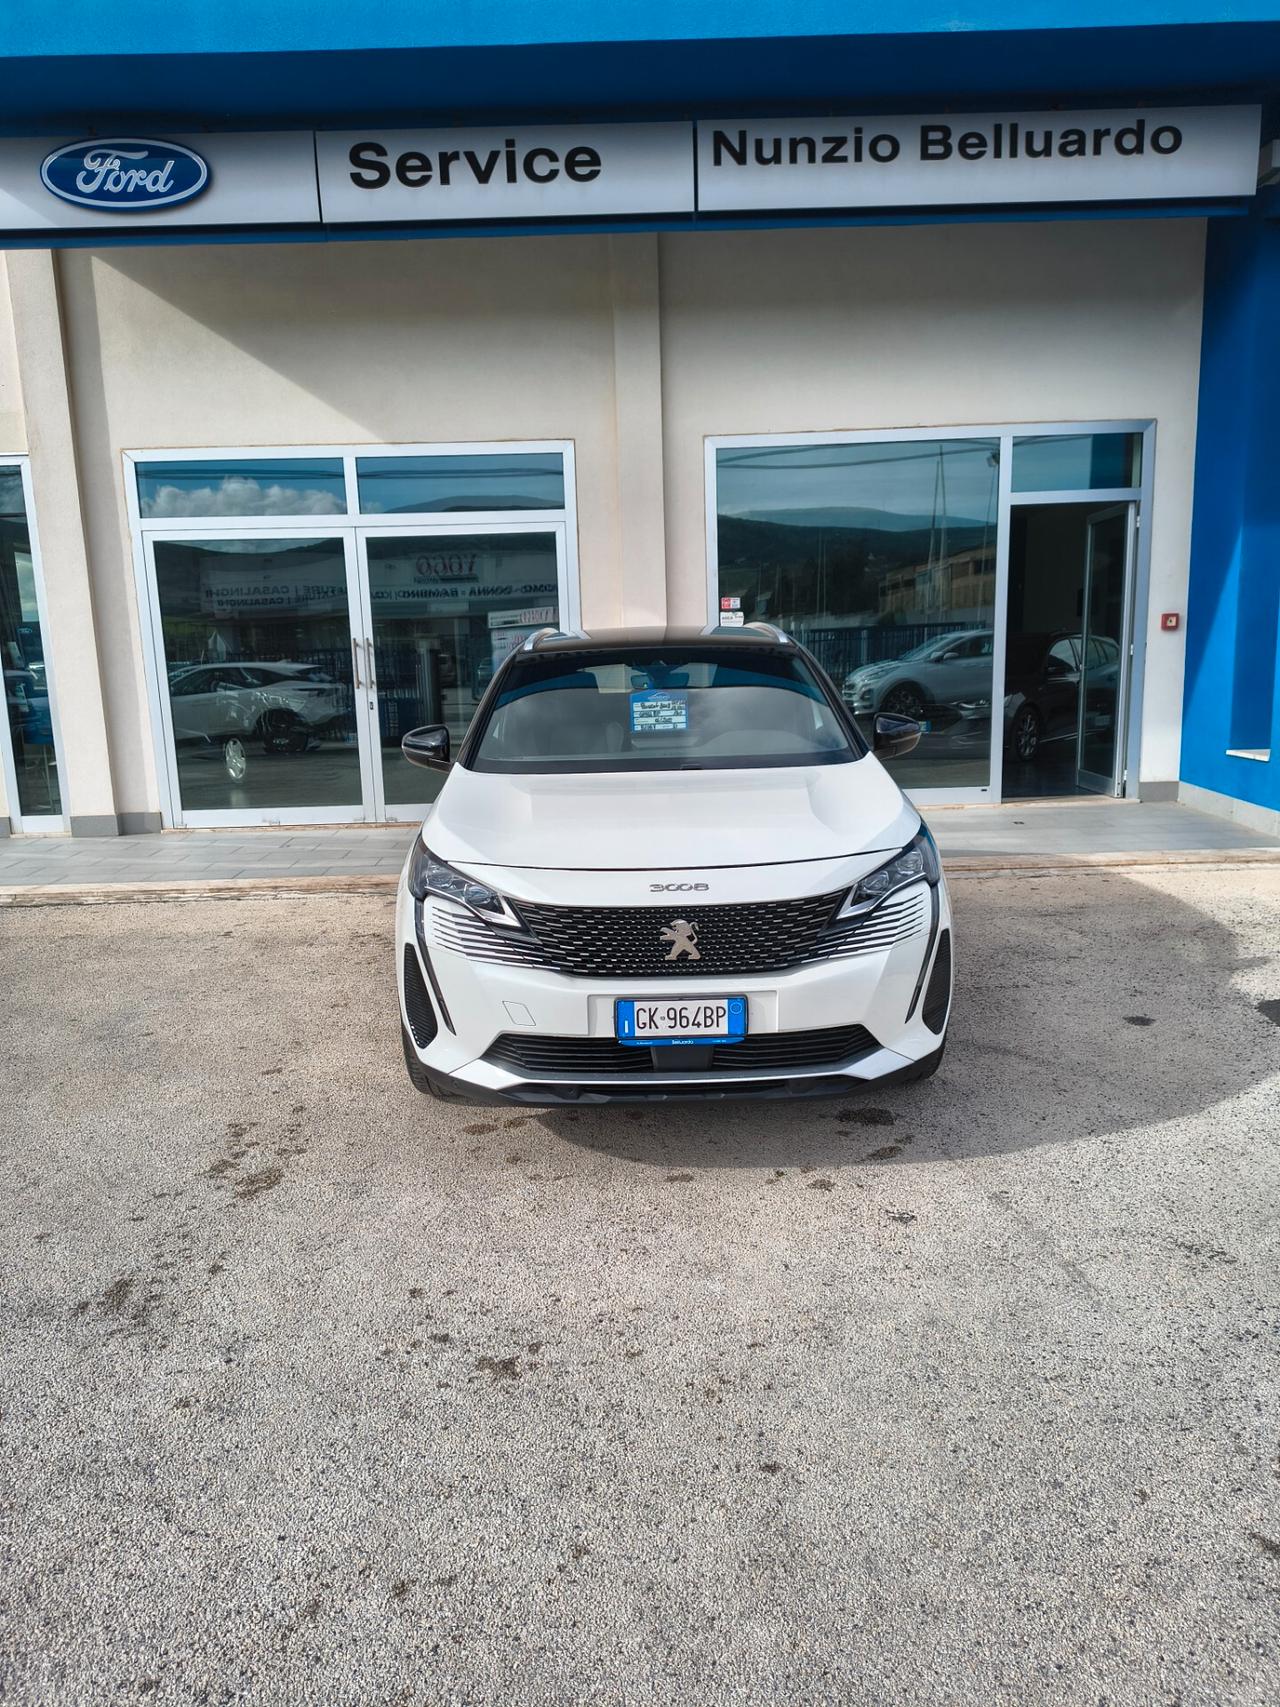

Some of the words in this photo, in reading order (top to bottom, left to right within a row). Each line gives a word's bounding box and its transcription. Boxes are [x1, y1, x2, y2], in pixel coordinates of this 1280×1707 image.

[349, 139, 602, 190] Service
[713, 126, 901, 166] Nunzio
[919, 118, 1184, 161] Belluardo
[76, 149, 175, 193] Ford
[649, 883, 710, 892] 3008
